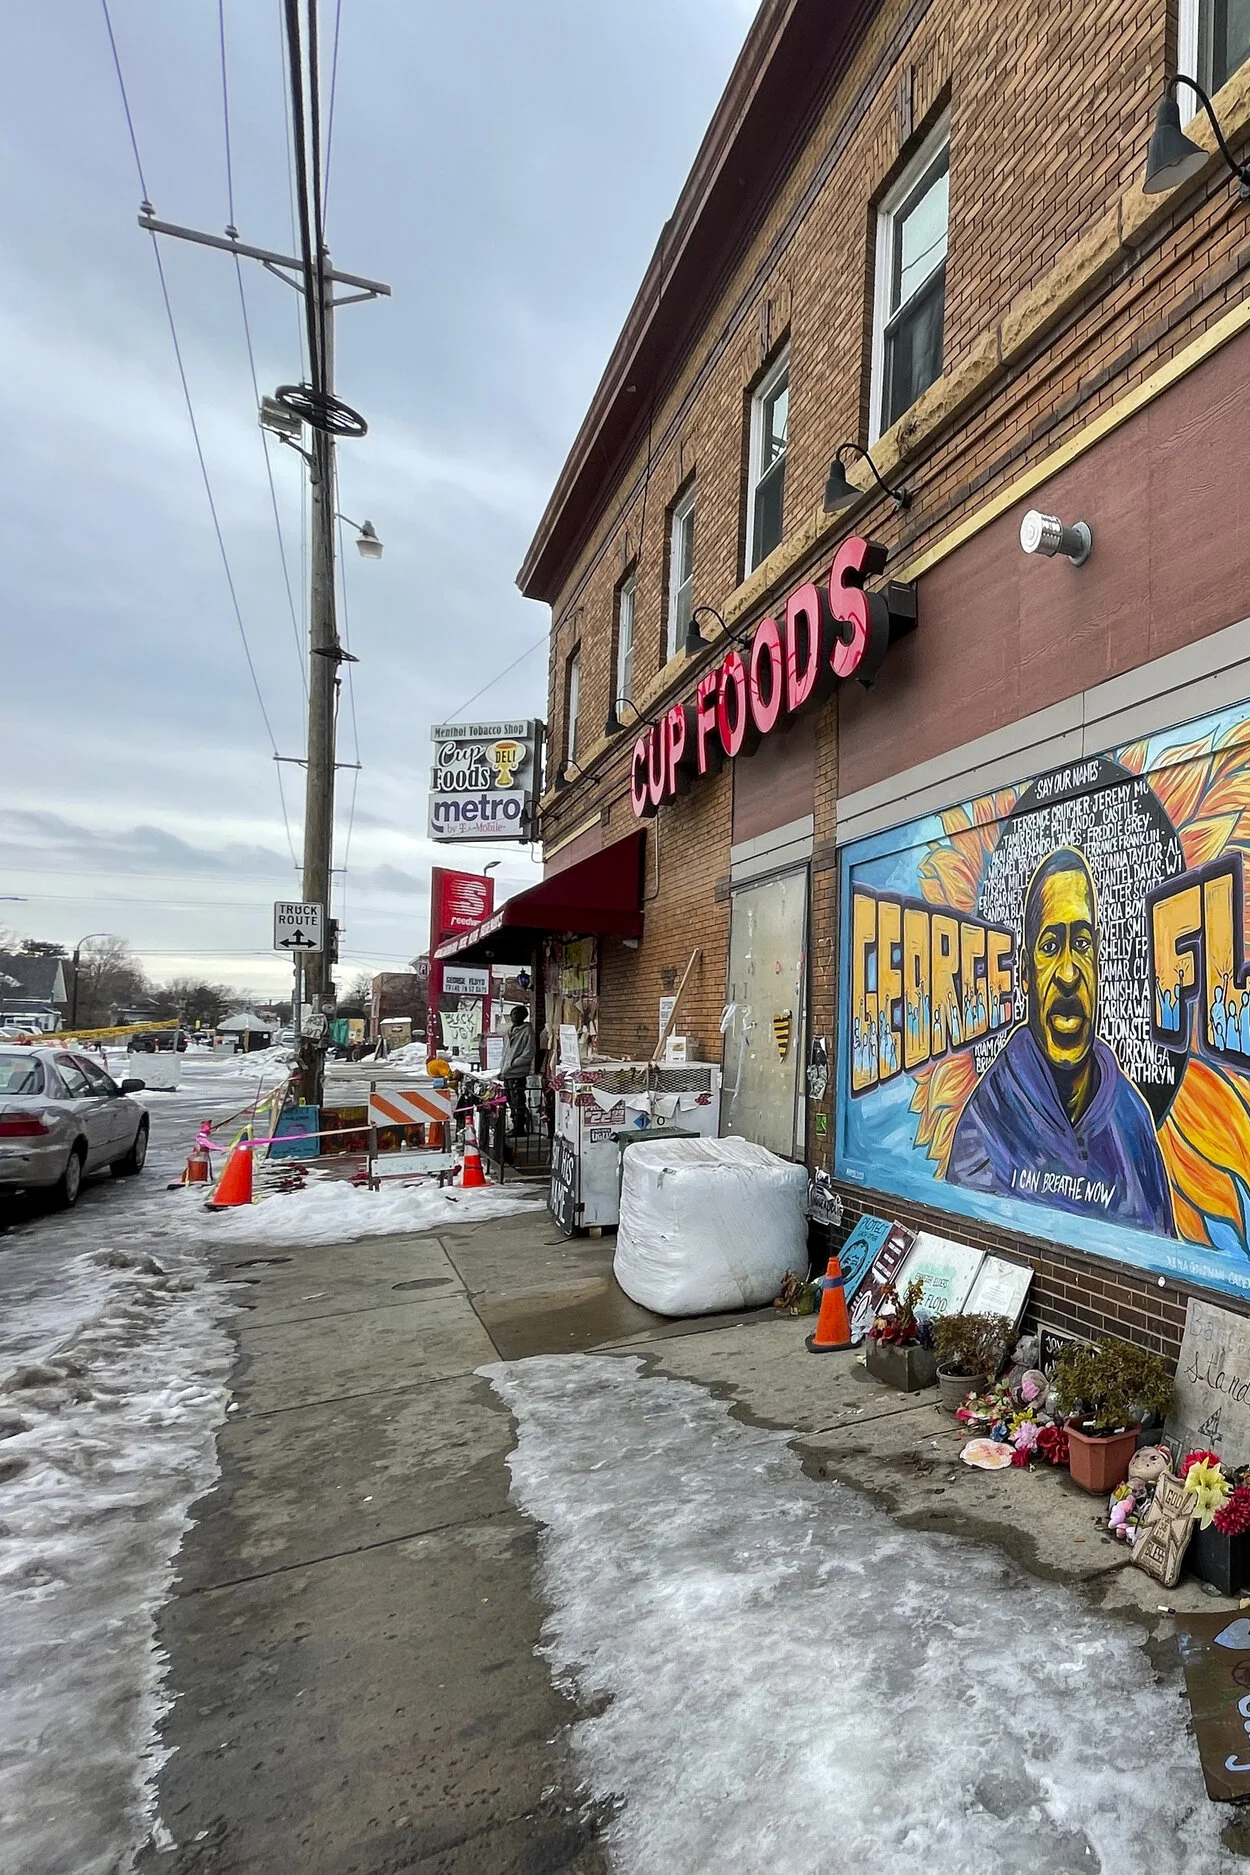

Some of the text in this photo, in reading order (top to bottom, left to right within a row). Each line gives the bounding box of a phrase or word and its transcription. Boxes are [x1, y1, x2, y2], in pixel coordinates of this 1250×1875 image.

[630, 535, 872, 817] CUP FOODS
[434, 724, 524, 738] Menthol Tobacco Shop
[439, 741, 487, 770] Cup
[495, 750, 516, 763] DELI
[431, 765, 491, 791] Foods
[1037, 760, 1099, 799] SAY OUR NAMES
[434, 794, 521, 822] metro
[1012, 809, 1050, 833] TERRENCE
[1051, 796, 1090, 823] CRUTCHER
[1092, 784, 1131, 813] JEREMY
[447, 823, 456, 834] by
[1025, 827, 1045, 845] RICE
[1051, 813, 1095, 836] PHILANDO
[1103, 800, 1138, 824] CASTILE
[1055, 829, 1082, 849] JAMES
[1087, 821, 1123, 843] FREDDIE
[1124, 812, 1149, 835] GREY
[1082, 828, 1159, 857] TERRANCE FRANKLIN
[1090, 837, 1181, 873] BREONNA TAYLOR AL
[1094, 867, 1133, 889] SHANTEL
[1134, 860, 1161, 882] DAVIS
[994, 890, 1023, 907] GARNER
[279, 915, 318, 925] ROUTE
[280, 905, 318, 915] TRUCK
[983, 906, 1010, 923] SANDRA
[1097, 902, 1123, 922] REKIA
[1100, 938, 1133, 960] SHELLY
[1100, 959, 1131, 980] JAMAR
[446, 976, 485, 986] GEORGE FLOYD
[852, 890, 1013, 1093] GEORGE
[1100, 979, 1151, 1000] TANISHA A
[444, 1012, 475, 1024] BLACK
[1100, 1000, 1133, 1019] TARIKA
[449, 1025, 474, 1040] JOY
[1099, 1018, 1150, 1040] ALTON STE
[1123, 1062, 1175, 1085] KATHRYN
[1011, 1169, 1116, 1209] I CAN BREATHE NOW
[924, 1293, 948, 1312] FLOYD
[1198, 1406, 1223, 1446] 4
[1165, 1489, 1184, 1509] GOD
